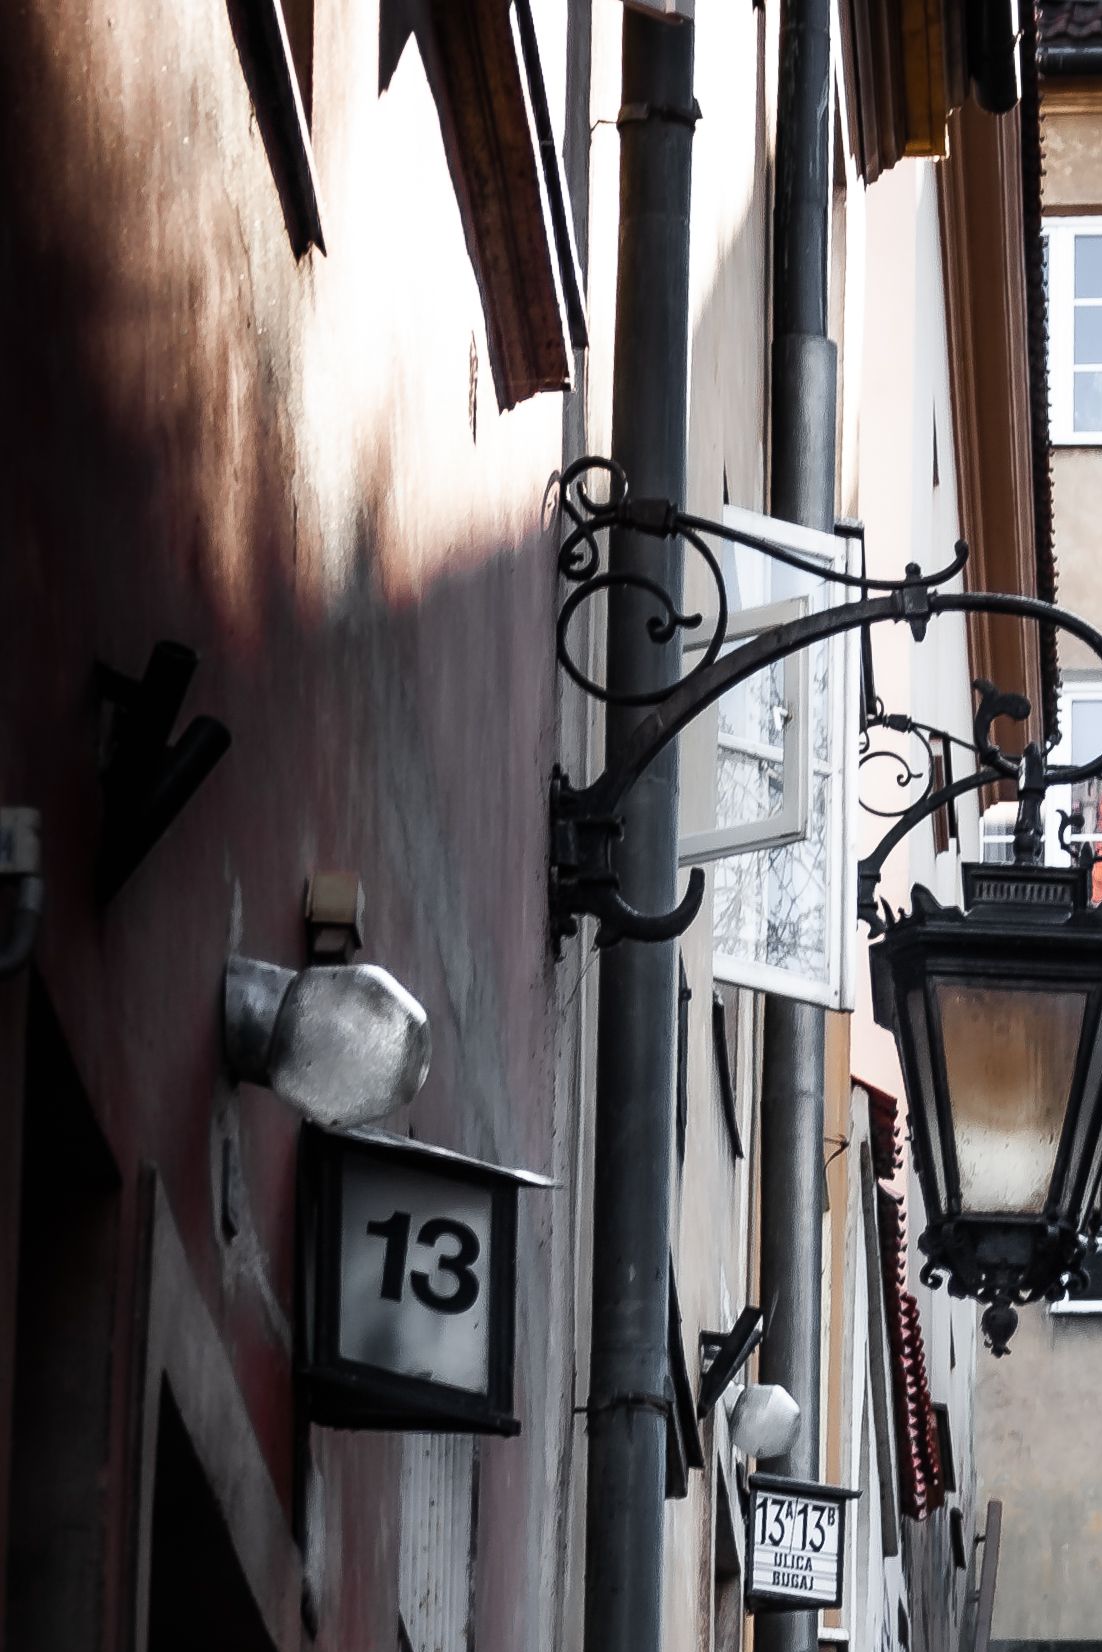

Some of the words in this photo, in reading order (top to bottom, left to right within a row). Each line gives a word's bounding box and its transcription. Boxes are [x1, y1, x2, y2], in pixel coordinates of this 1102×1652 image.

[366, 1211, 481, 1316] 13
[774, 1552, 813, 1572] ULICA
[772, 1571, 815, 1591] BUGAJ
